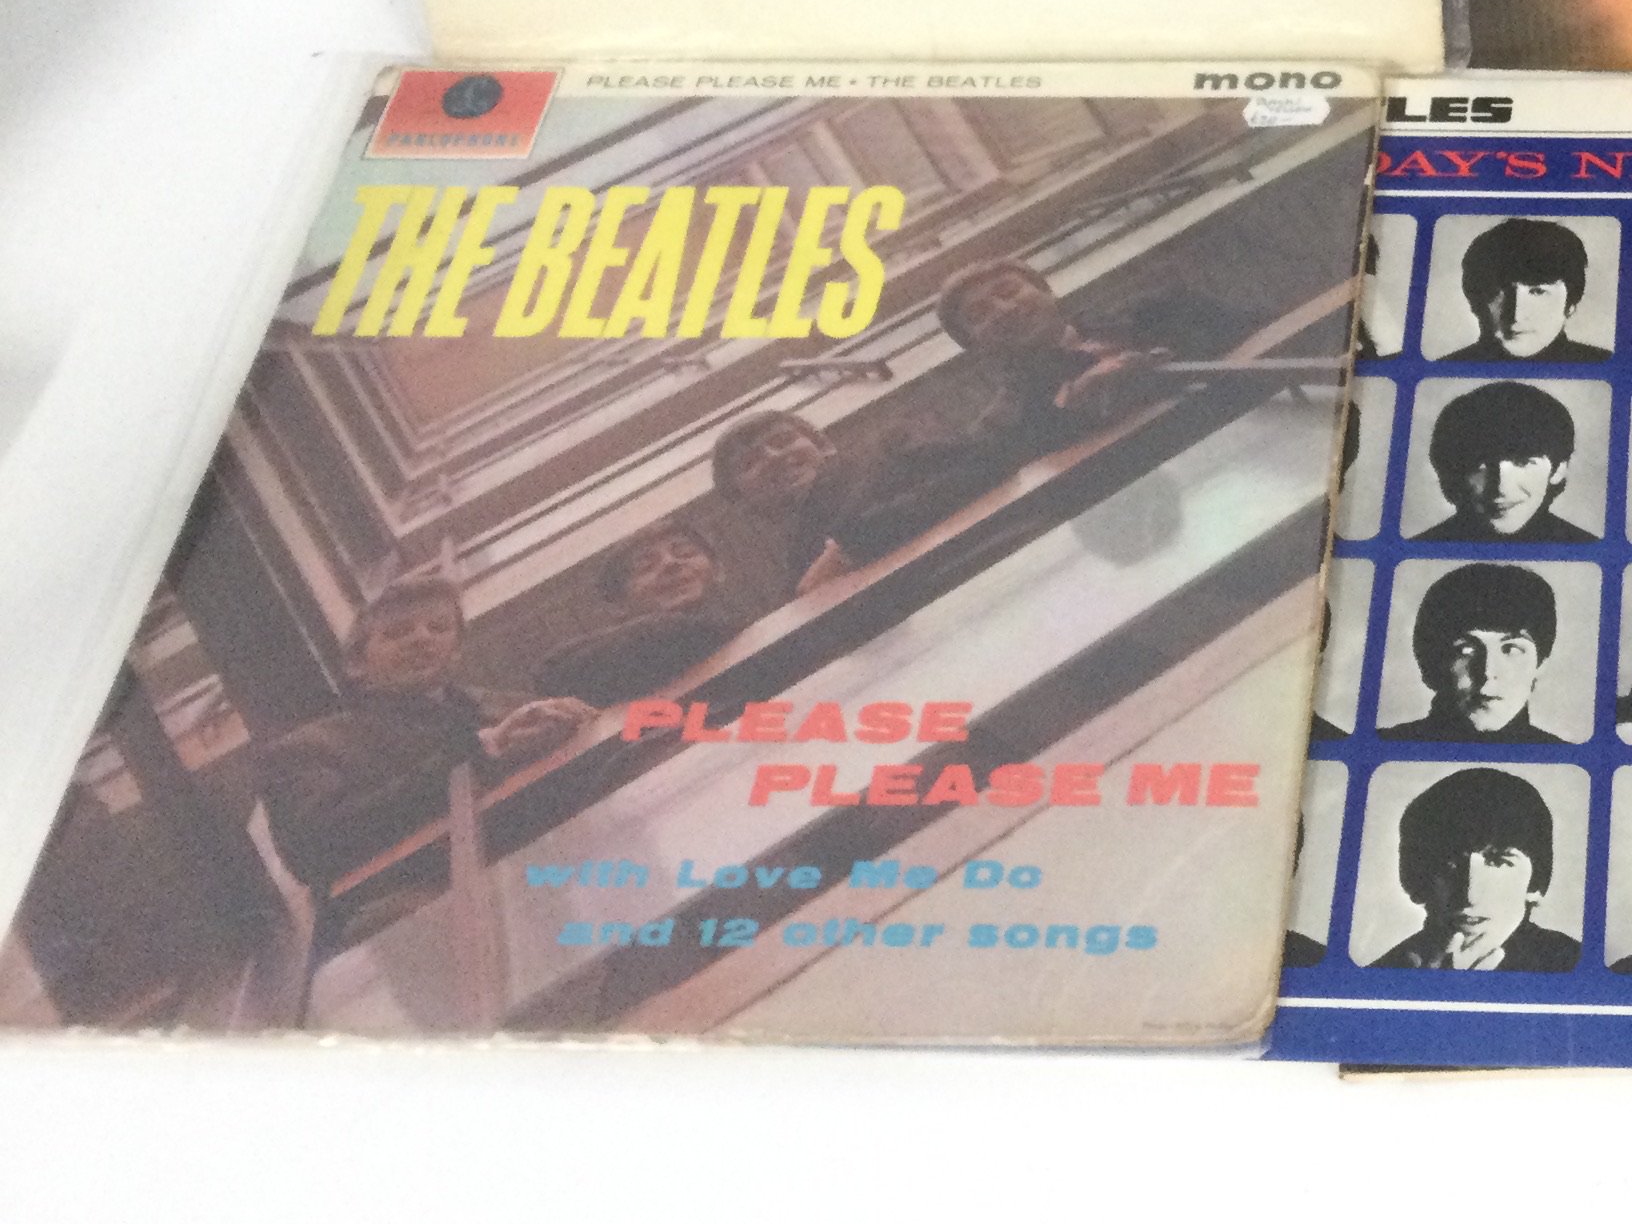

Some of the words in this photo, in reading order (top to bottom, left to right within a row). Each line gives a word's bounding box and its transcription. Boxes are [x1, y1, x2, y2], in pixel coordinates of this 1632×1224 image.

[586, 75, 685, 90] PLEASE
[695, 75, 795, 90] PLEASE
[803, 75, 842, 90] ME
[867, 75, 916, 90] THE
[926, 75, 1043, 90] BEATLES
[1192, 70, 1344, 92] mono
[1385, 96, 1514, 124] LES
[310, 185, 521, 339] THE
[491, 184, 907, 339] BEATLES
[621, 700, 973, 744] PLEASE
[747, 763, 1105, 807] PLEASE
[1126, 763, 1263, 807] ME
[526, 858, 651, 890] with
[676, 859, 823, 890] Love
[848, 859, 939, 890] Me
[962, 859, 1043, 890] Do
[556, 918, 675, 947] and
[698, 918, 761, 948] 12
[783, 919, 945, 949] other
[966, 922, 1159, 956] songs
